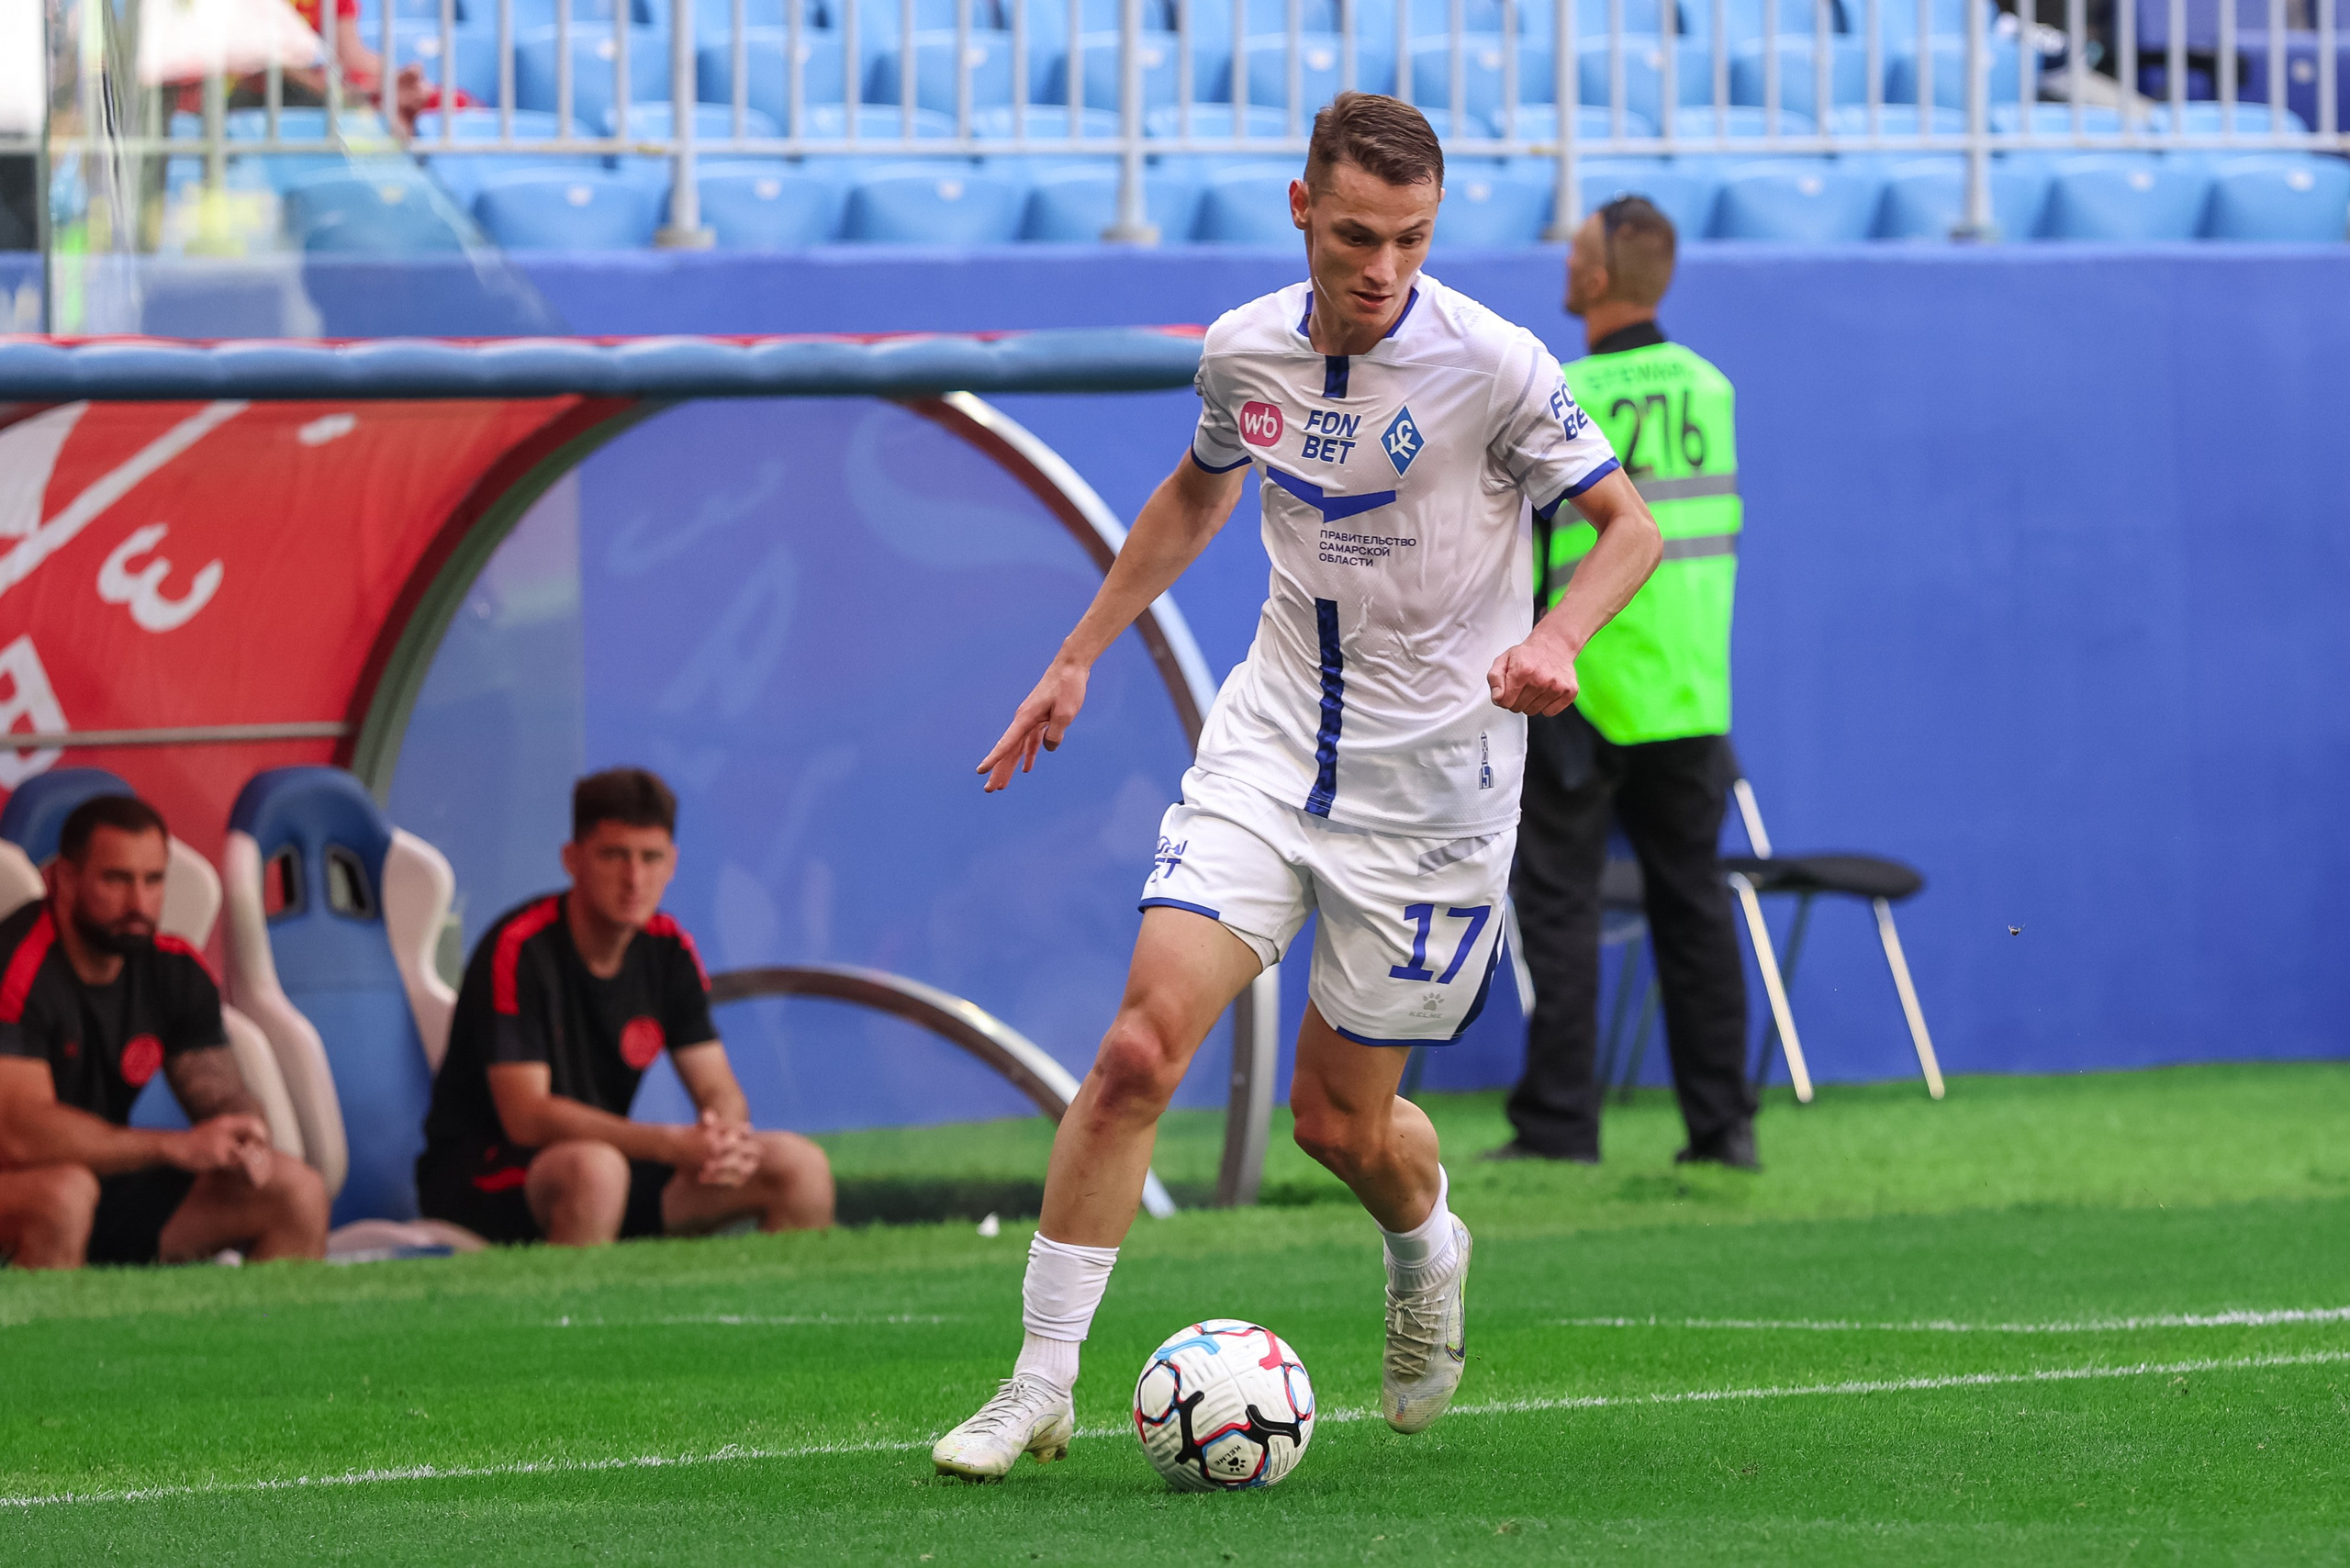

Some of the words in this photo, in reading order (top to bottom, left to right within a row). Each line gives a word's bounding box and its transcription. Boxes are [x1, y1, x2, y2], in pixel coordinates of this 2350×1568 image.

[1550, 383, 1575, 420] FO
[1245, 407, 1278, 439] wb
[1304, 409, 1361, 438] FON
[1563, 406, 1588, 441] BE
[1610, 389, 1705, 475] 276
[1301, 435, 1356, 465] BET
[1319, 542, 1390, 556] САМАРСКОЙ
[1320, 530, 1416, 546] ПРАВИТЕЛЬСТВО
[1318, 553, 1373, 566] ОБЛАСТИ
[1388, 902, 1492, 984] 17
[1408, 1011, 1444, 1019] KELME
[1214, 1444, 1242, 1467] KELME
